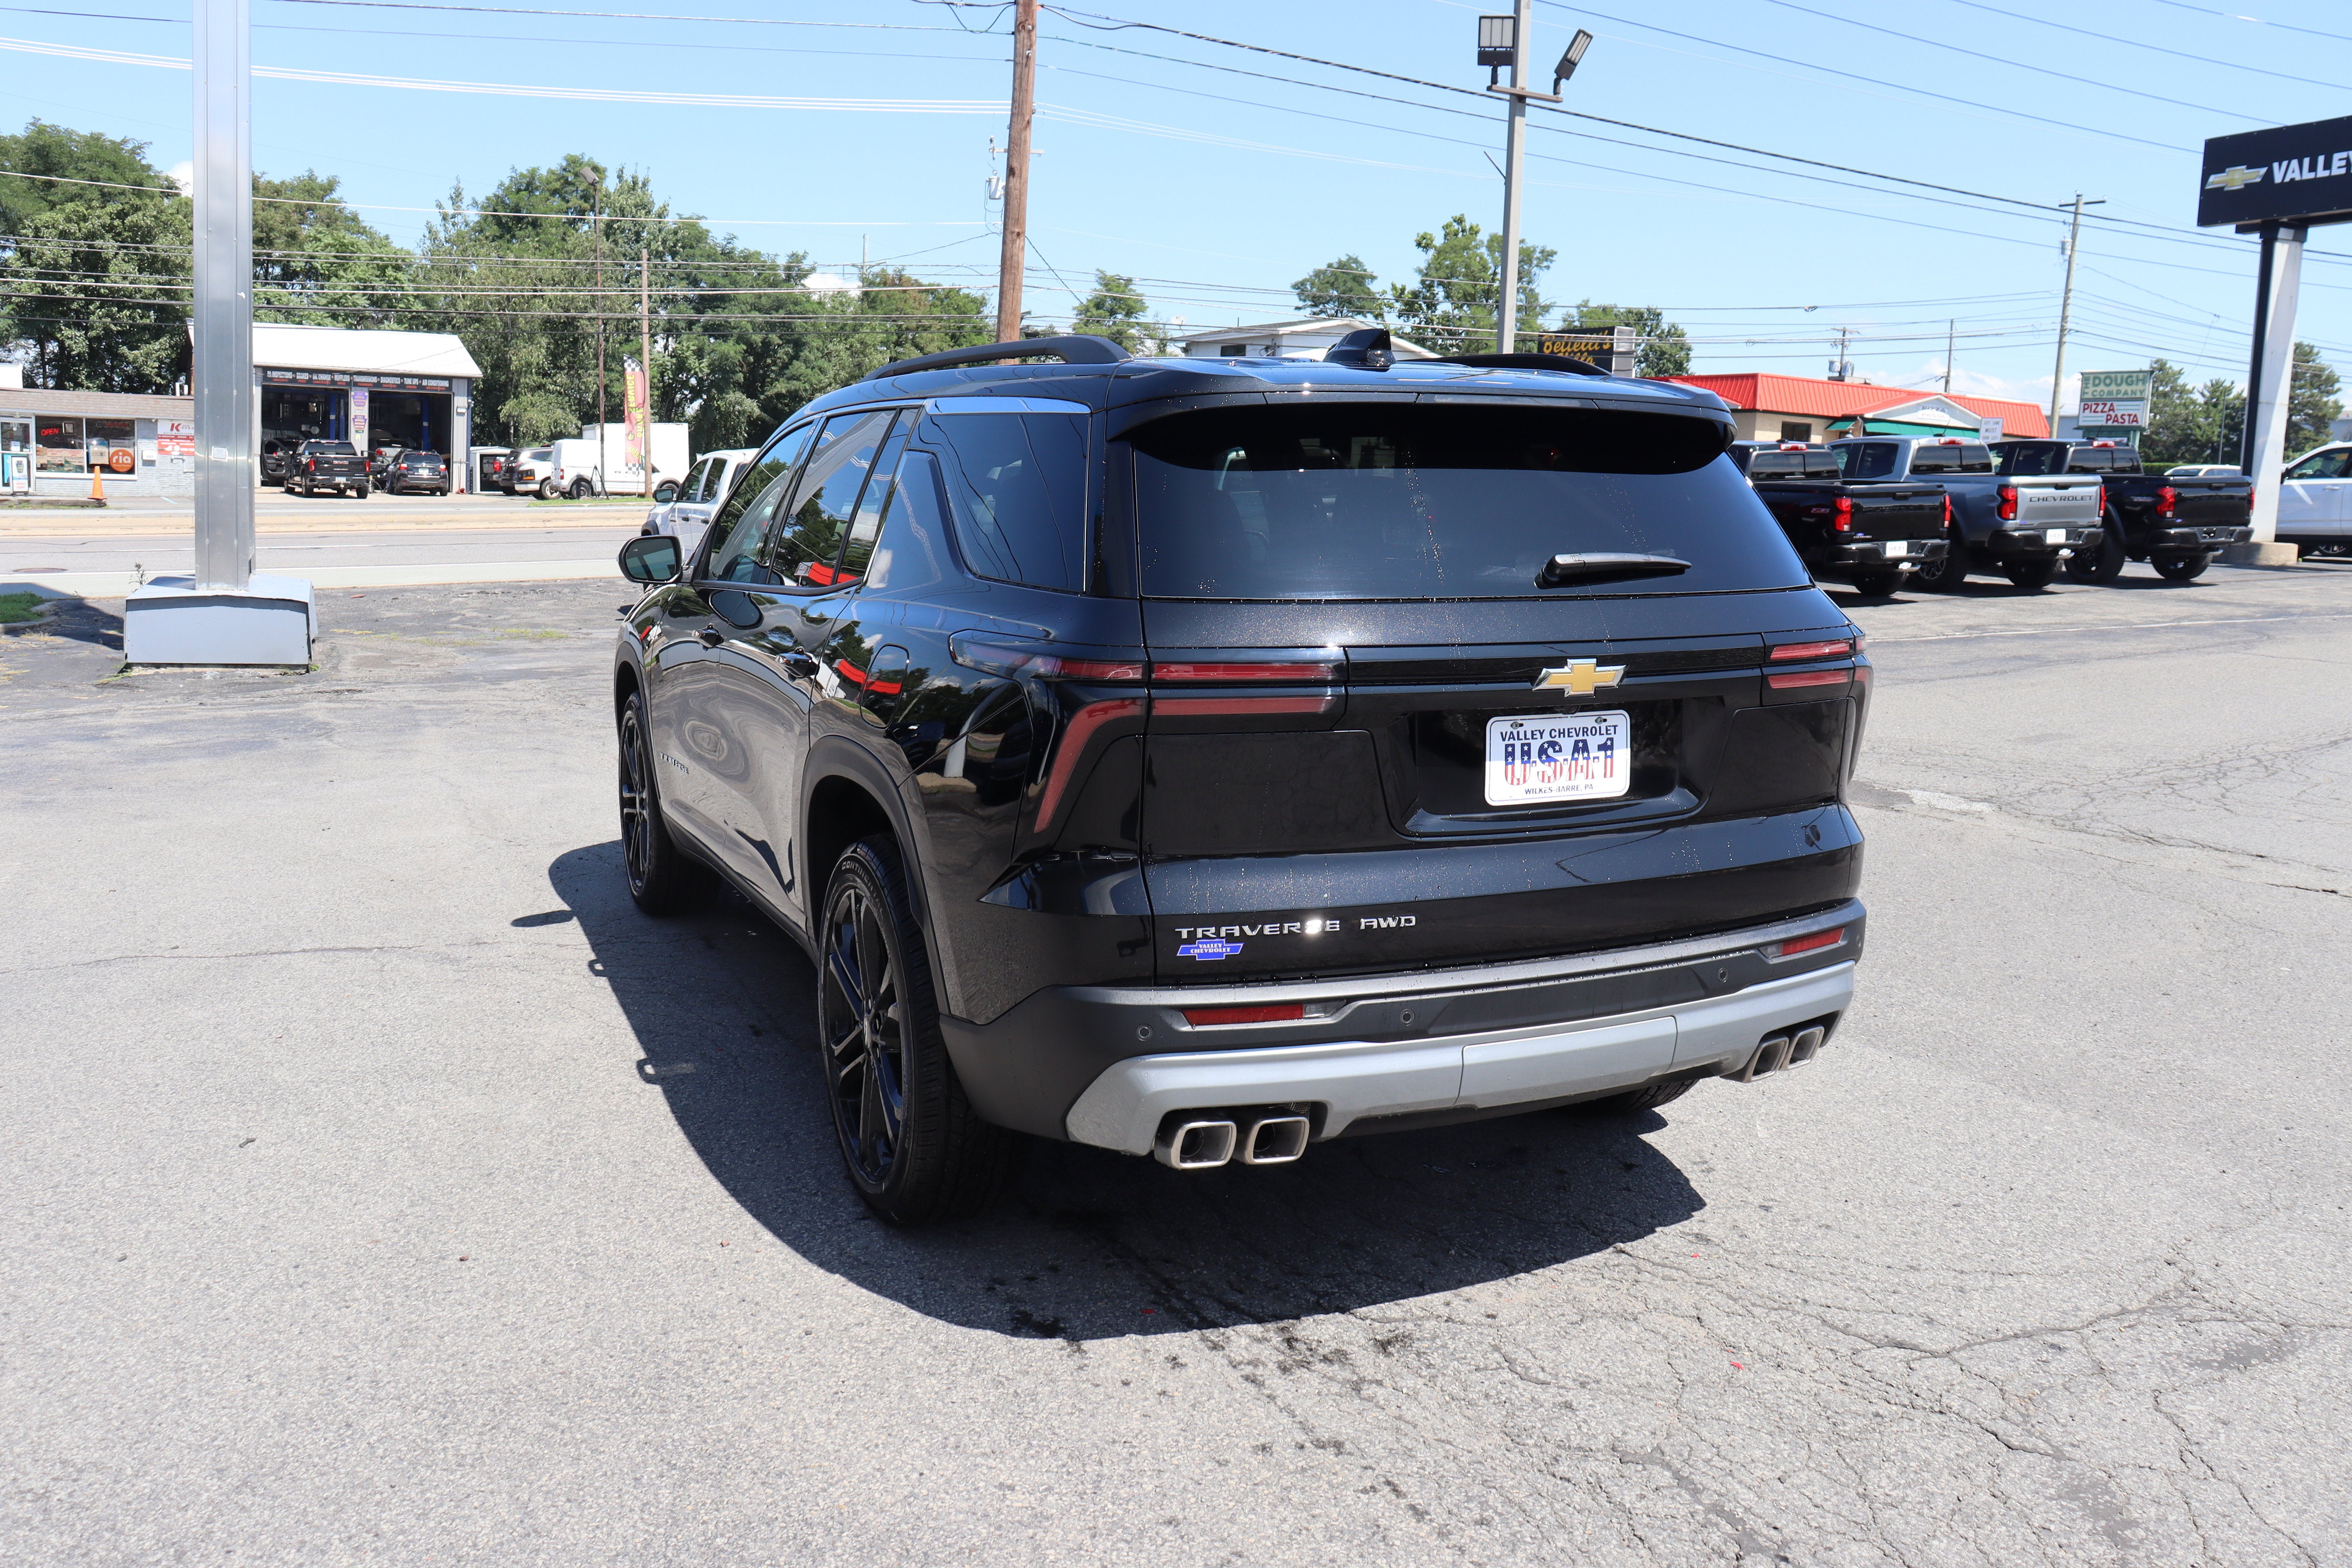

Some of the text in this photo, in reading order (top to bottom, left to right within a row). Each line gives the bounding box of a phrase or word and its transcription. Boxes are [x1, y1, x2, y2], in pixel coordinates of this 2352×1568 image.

[353, 375, 377, 383] TRANSMISSIONS
[380, 376, 401, 384] DIAGNOSTICS
[2092, 374, 2146, 388] DOUGH
[2091, 389, 2145, 397] COMPANY
[2082, 402, 2116, 413] PIZZA
[2105, 413, 2139, 424] PASTA
[41, 428, 59, 436] OPEN
[113, 452, 131, 463] ria
[1500, 725, 1618, 742] VALLEY CHEVROLET
[1175, 915, 1416, 938] TRAVERSE AWD
